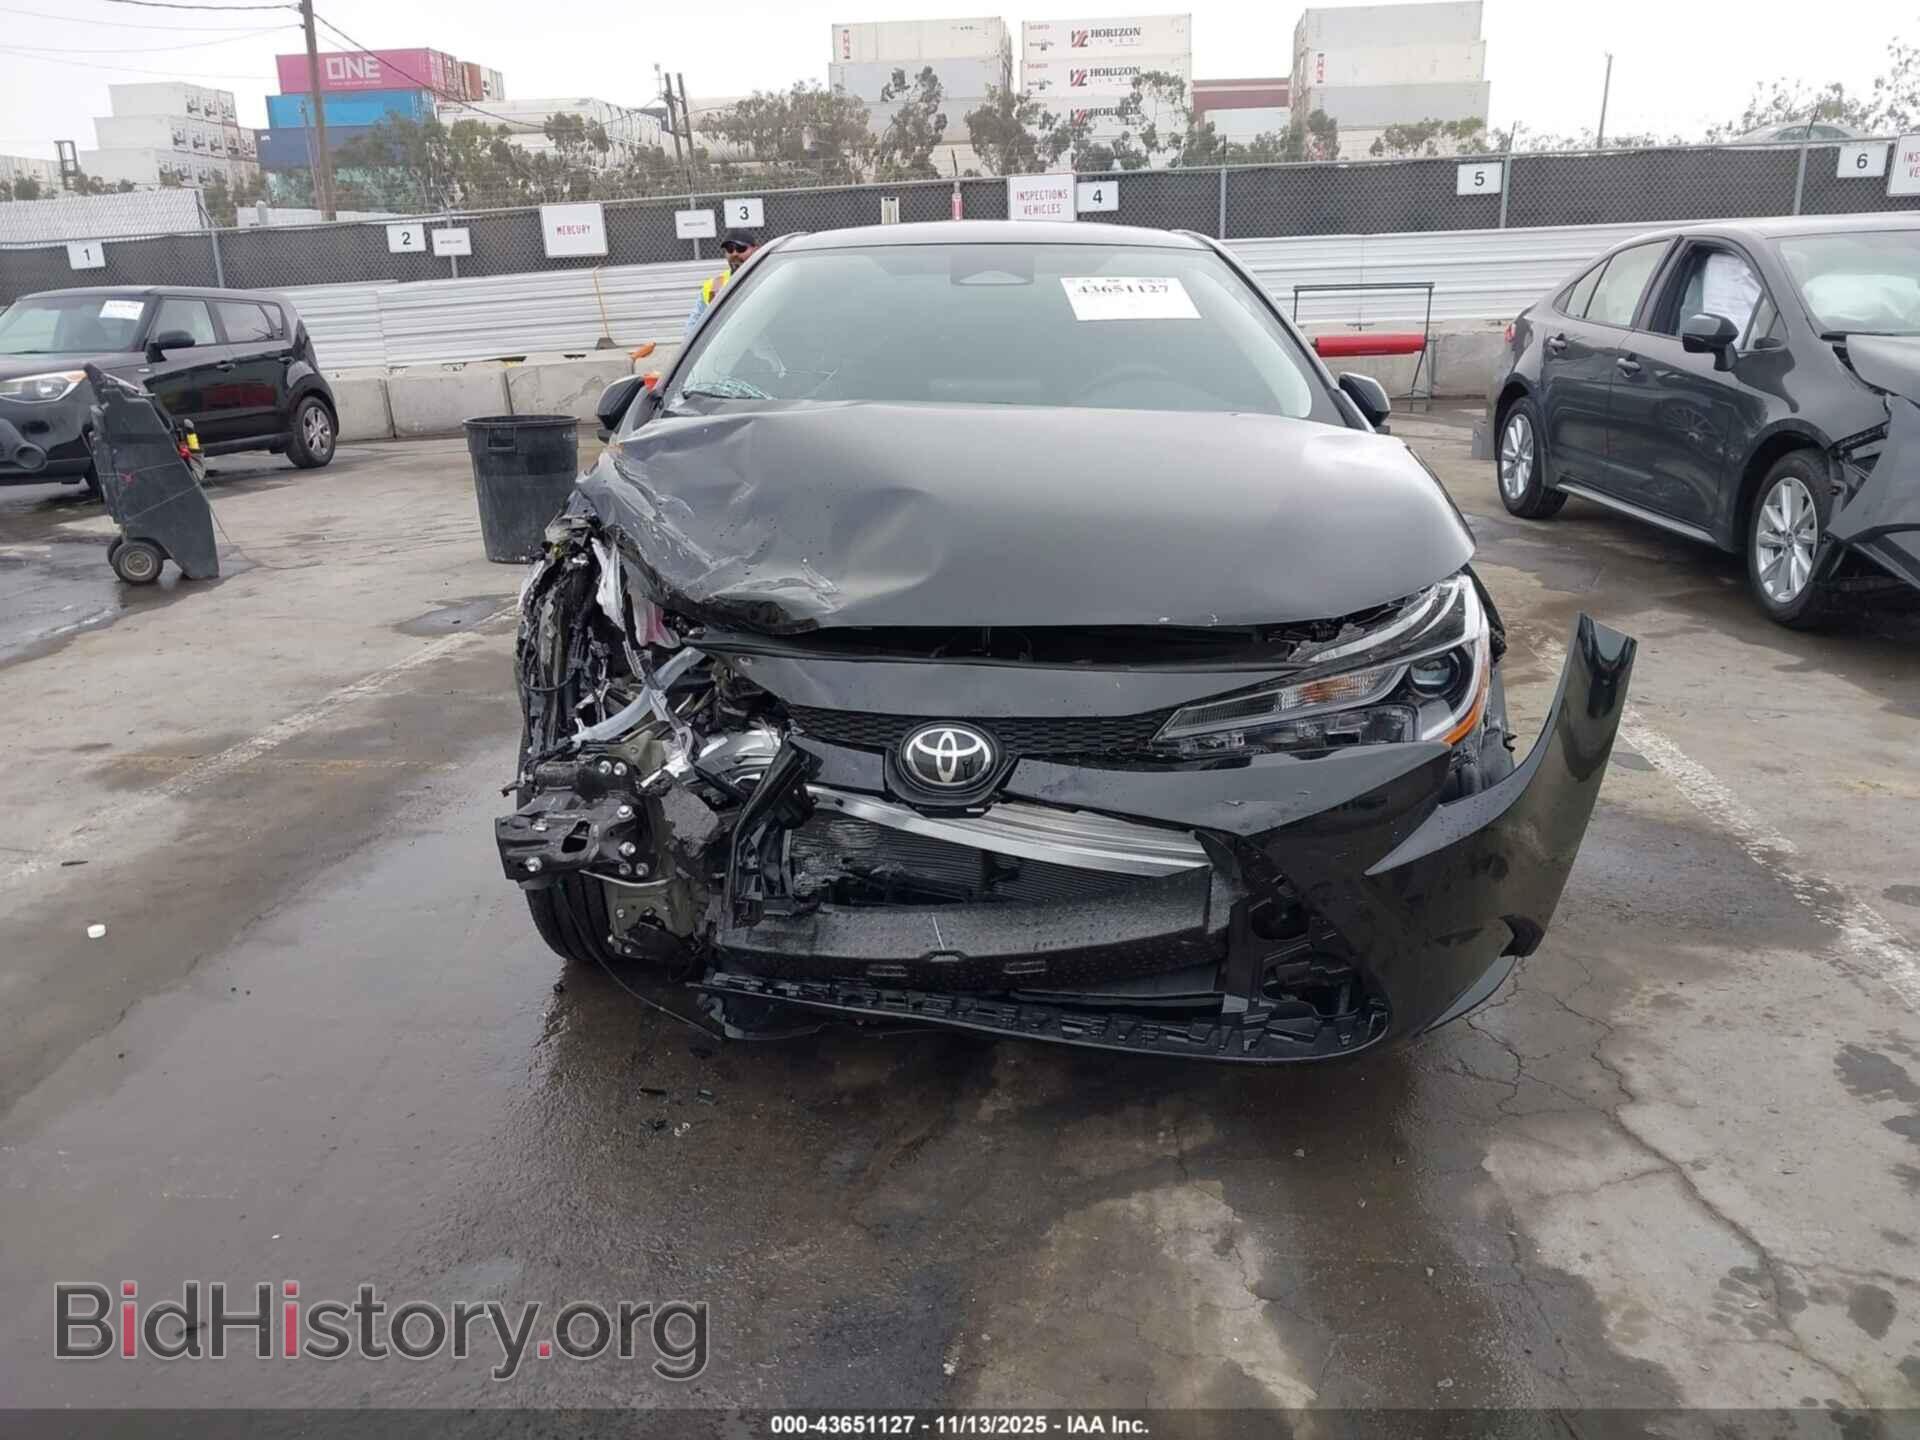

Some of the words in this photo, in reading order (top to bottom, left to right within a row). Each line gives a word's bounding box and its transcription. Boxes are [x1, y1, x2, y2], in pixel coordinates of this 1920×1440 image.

[1090, 27, 1142, 38] HORIZON
[326, 56, 380, 80] ONE
[1089, 66, 1140, 77] HORIZON
[1856, 153, 1868, 169] 6
[1474, 171, 1485, 186] 5
[1016, 188, 1068, 201] INSPECTIONS
[1092, 189, 1103, 204] 4
[739, 206, 749, 220] 3
[1024, 203, 1061, 215] VEHICLES
[556, 224, 590, 236] MERCURY
[401, 231, 412, 245] 2
[84, 248, 91, 261] 1
